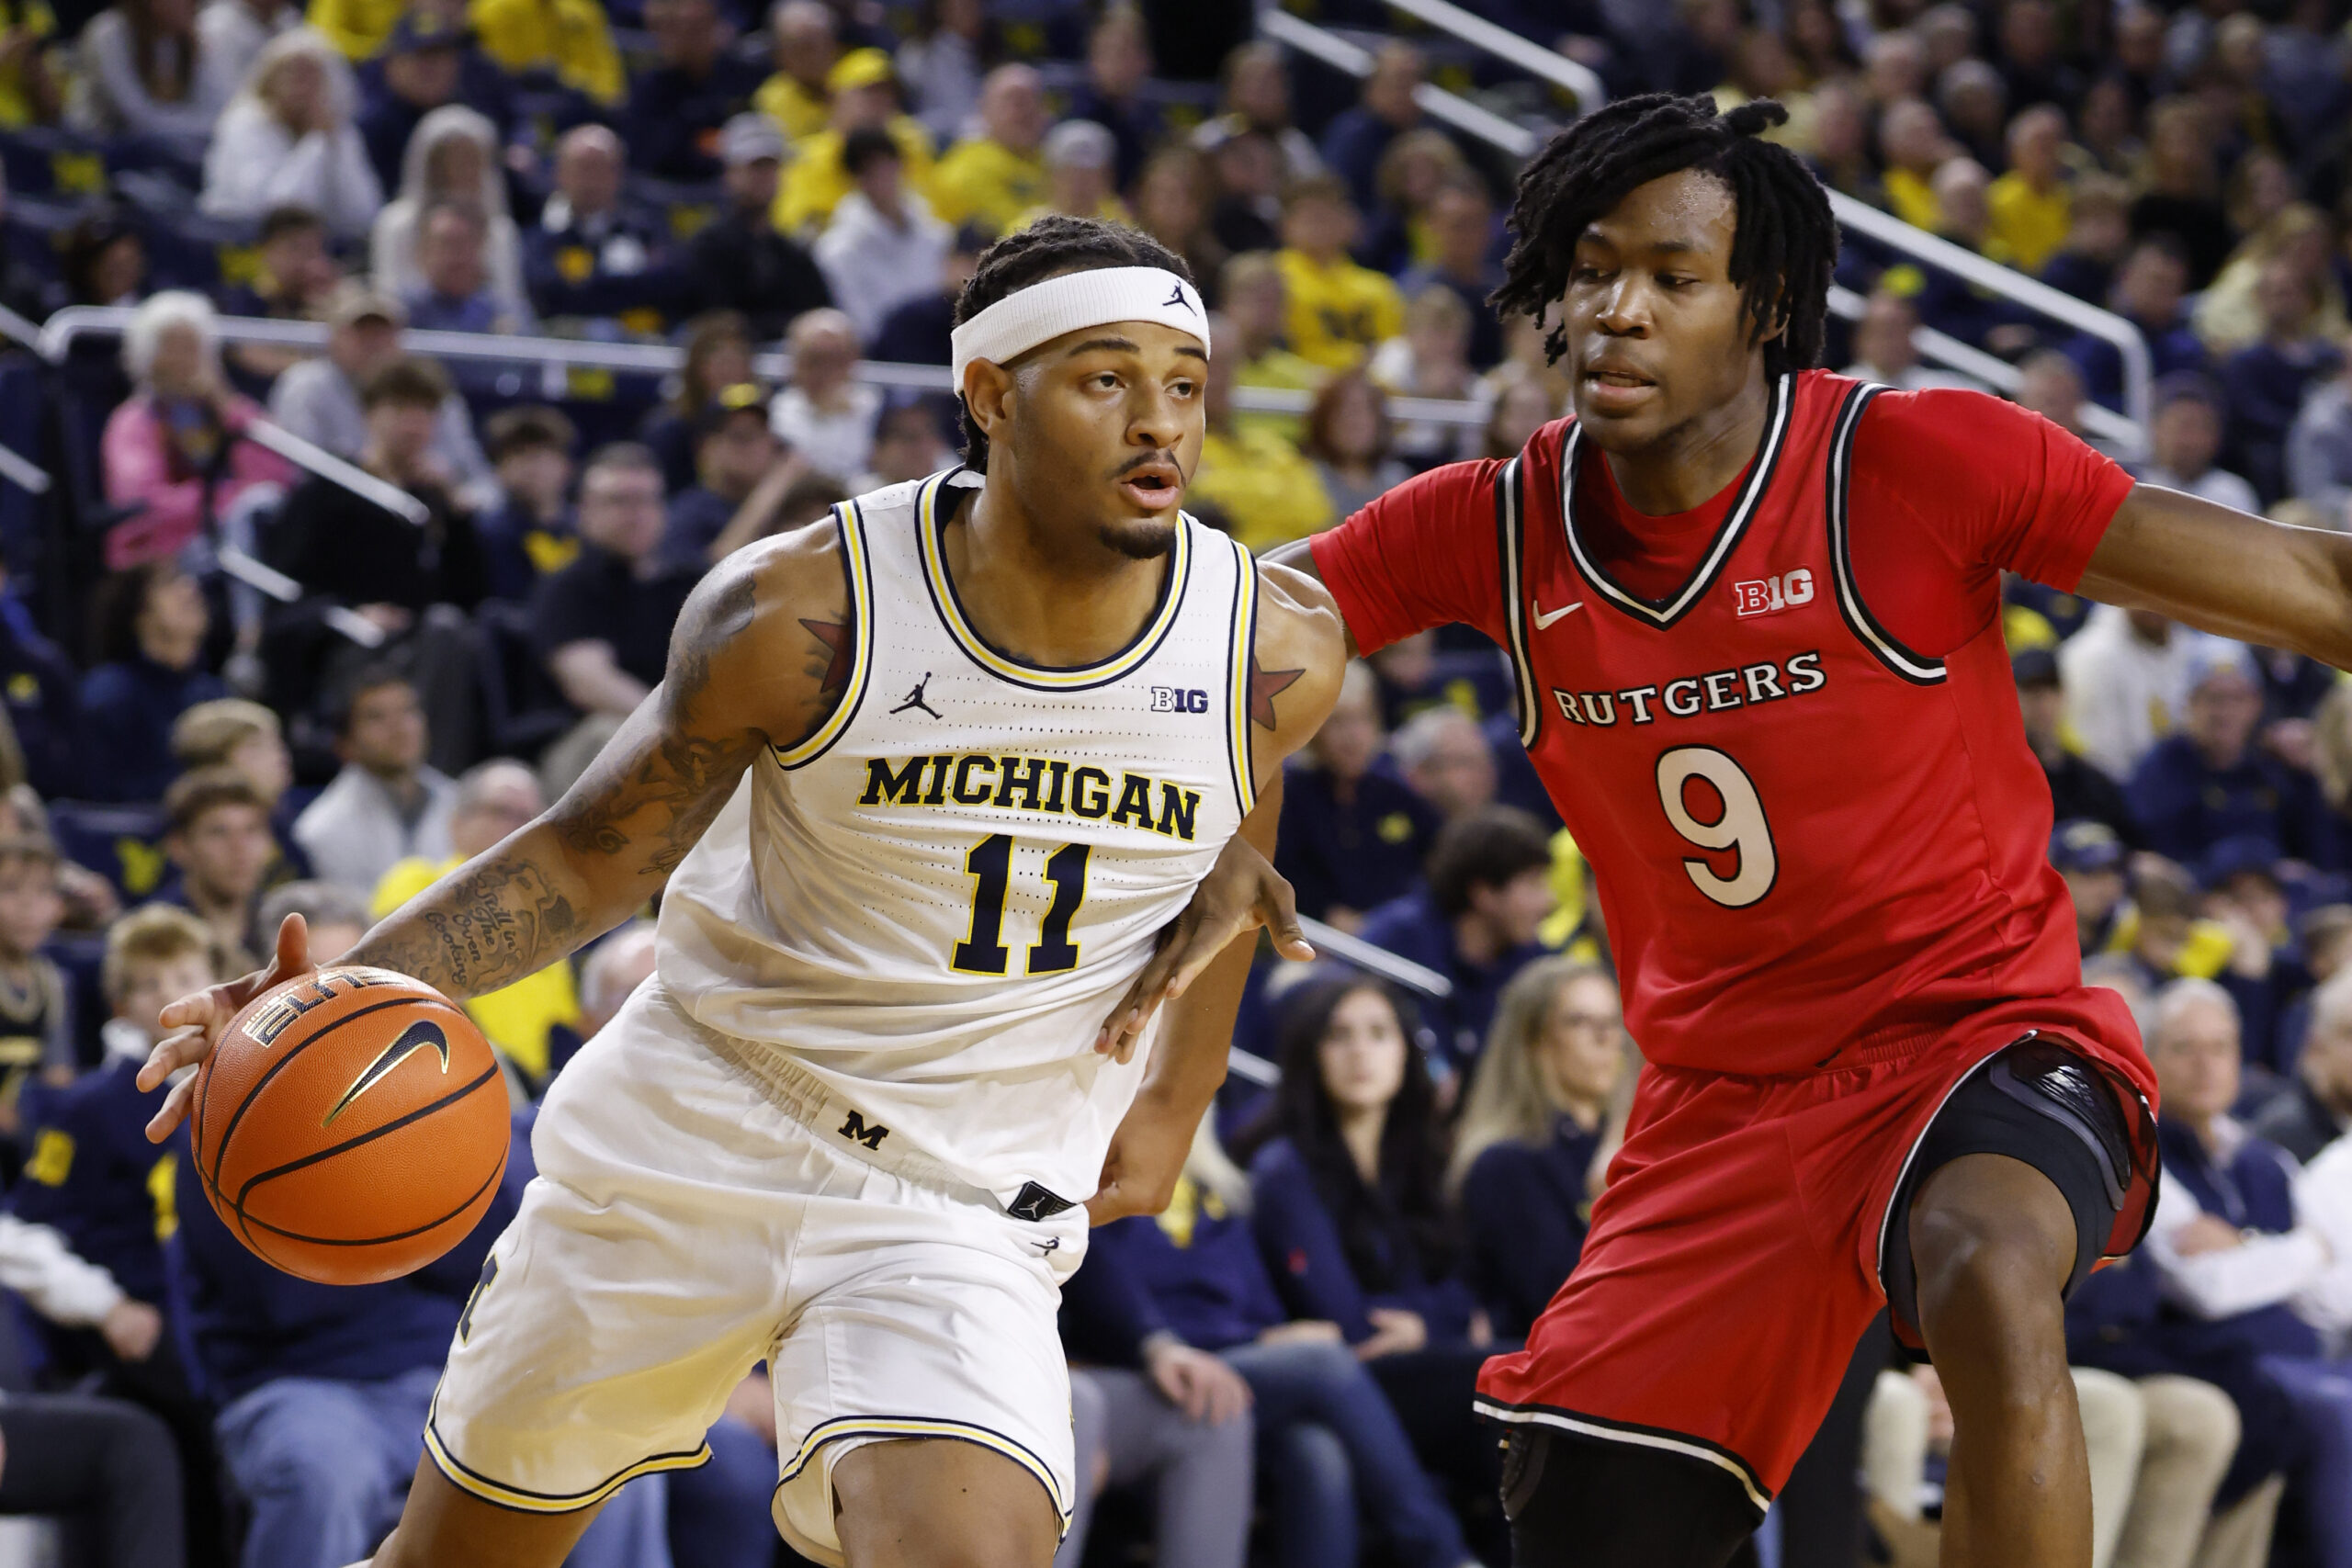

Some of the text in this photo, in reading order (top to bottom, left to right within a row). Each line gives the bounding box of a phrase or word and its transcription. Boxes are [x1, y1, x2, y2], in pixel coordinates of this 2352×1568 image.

[1552, 649, 1827, 727] RUTGERS
[856, 753, 1201, 842] MICHIGAN
[1655, 743, 1780, 910] 9
[453, 914, 481, 964] Oven
[950, 834, 1092, 976] 11
[837, 1110, 889, 1150] M
